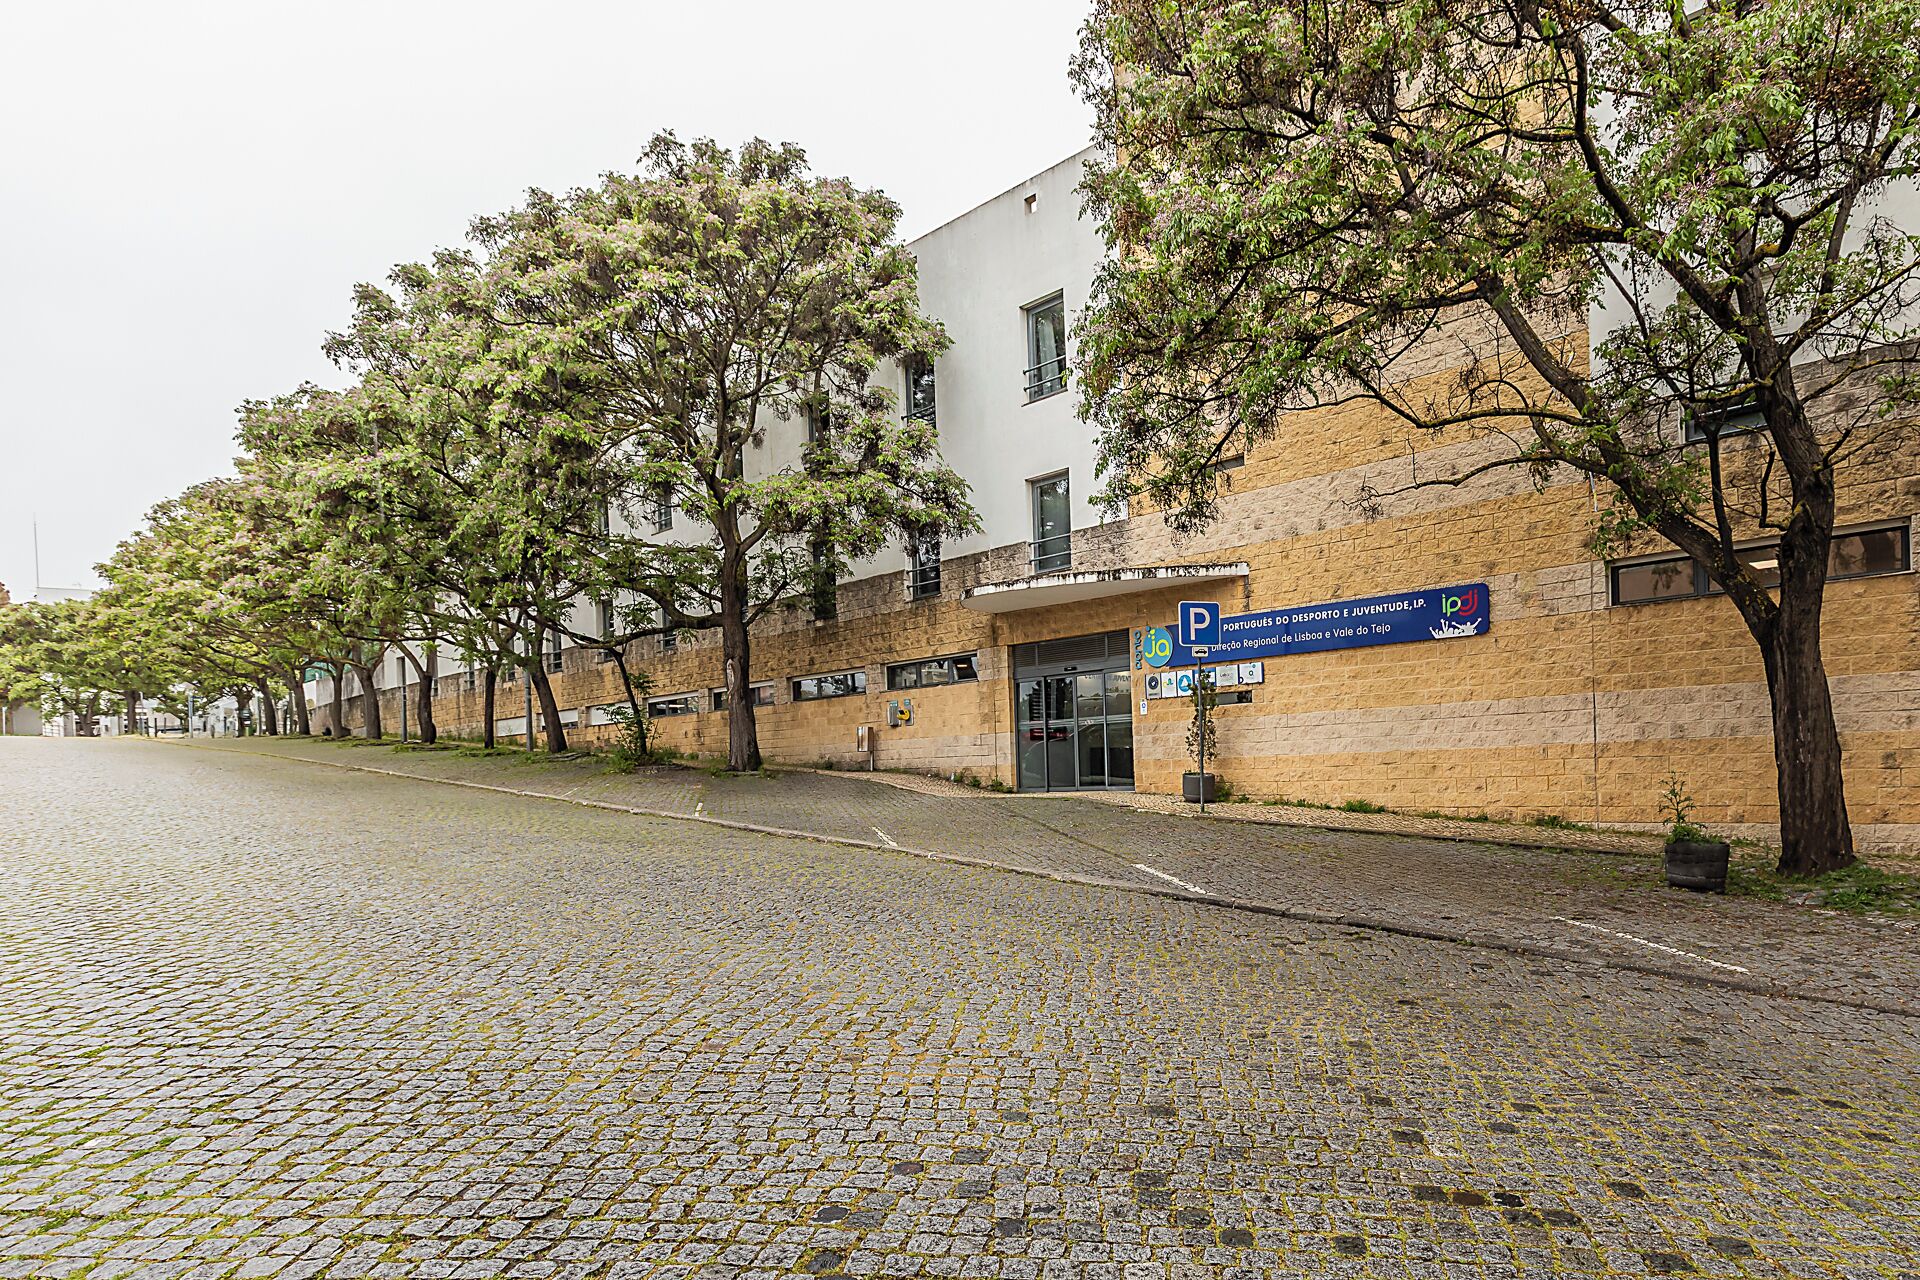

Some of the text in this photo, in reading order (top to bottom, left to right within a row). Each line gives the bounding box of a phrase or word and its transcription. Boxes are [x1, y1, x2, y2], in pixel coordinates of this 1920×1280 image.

[1276, 616, 1289, 625] DO
[1292, 610, 1340, 623] DESPORTO
[1343, 608, 1349, 617] E
[1351, 601, 1412, 617] JUVENTUDE,
[1413, 599, 1427, 608] I.P.
[1441, 588, 1478, 617] ipdj
[1190, 608, 1210, 640] P
[1243, 635, 1279, 649] Regional
[1281, 633, 1293, 643] de
[1294, 631, 1323, 642] Lisboa
[1325, 630, 1331, 638] e
[1333, 626, 1354, 638] Vale
[1356, 625, 1369, 635] do
[1370, 623, 1391, 635] Tejo
